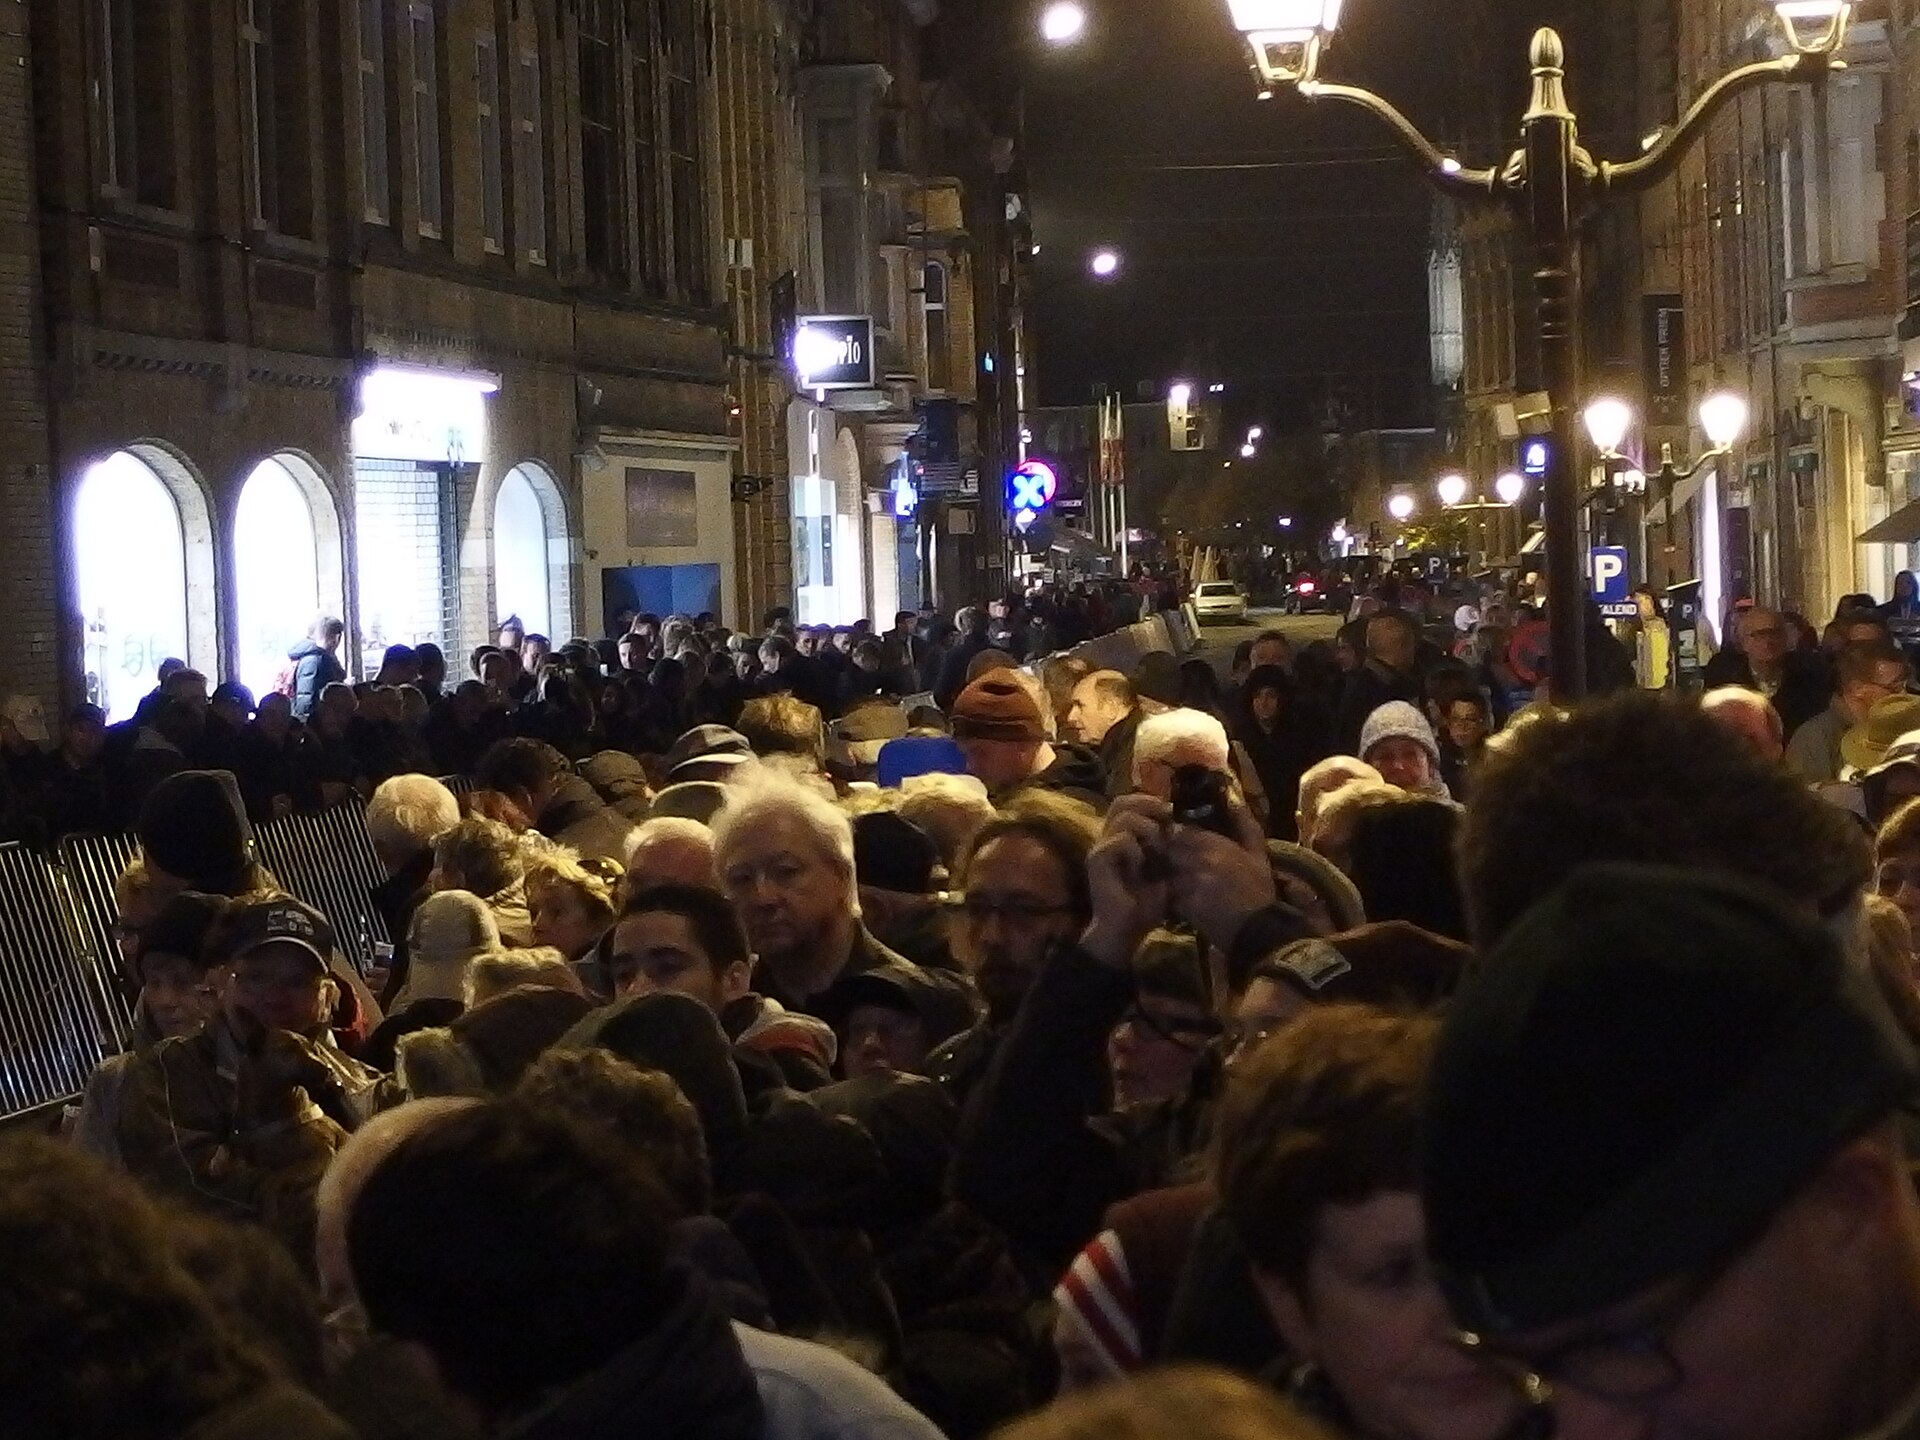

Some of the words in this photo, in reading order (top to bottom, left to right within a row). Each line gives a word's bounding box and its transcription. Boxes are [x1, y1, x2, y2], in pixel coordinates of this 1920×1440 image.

[1429, 557, 1441, 575] P
[1595, 554, 1622, 593] P
[1682, 604, 1693, 619] P
